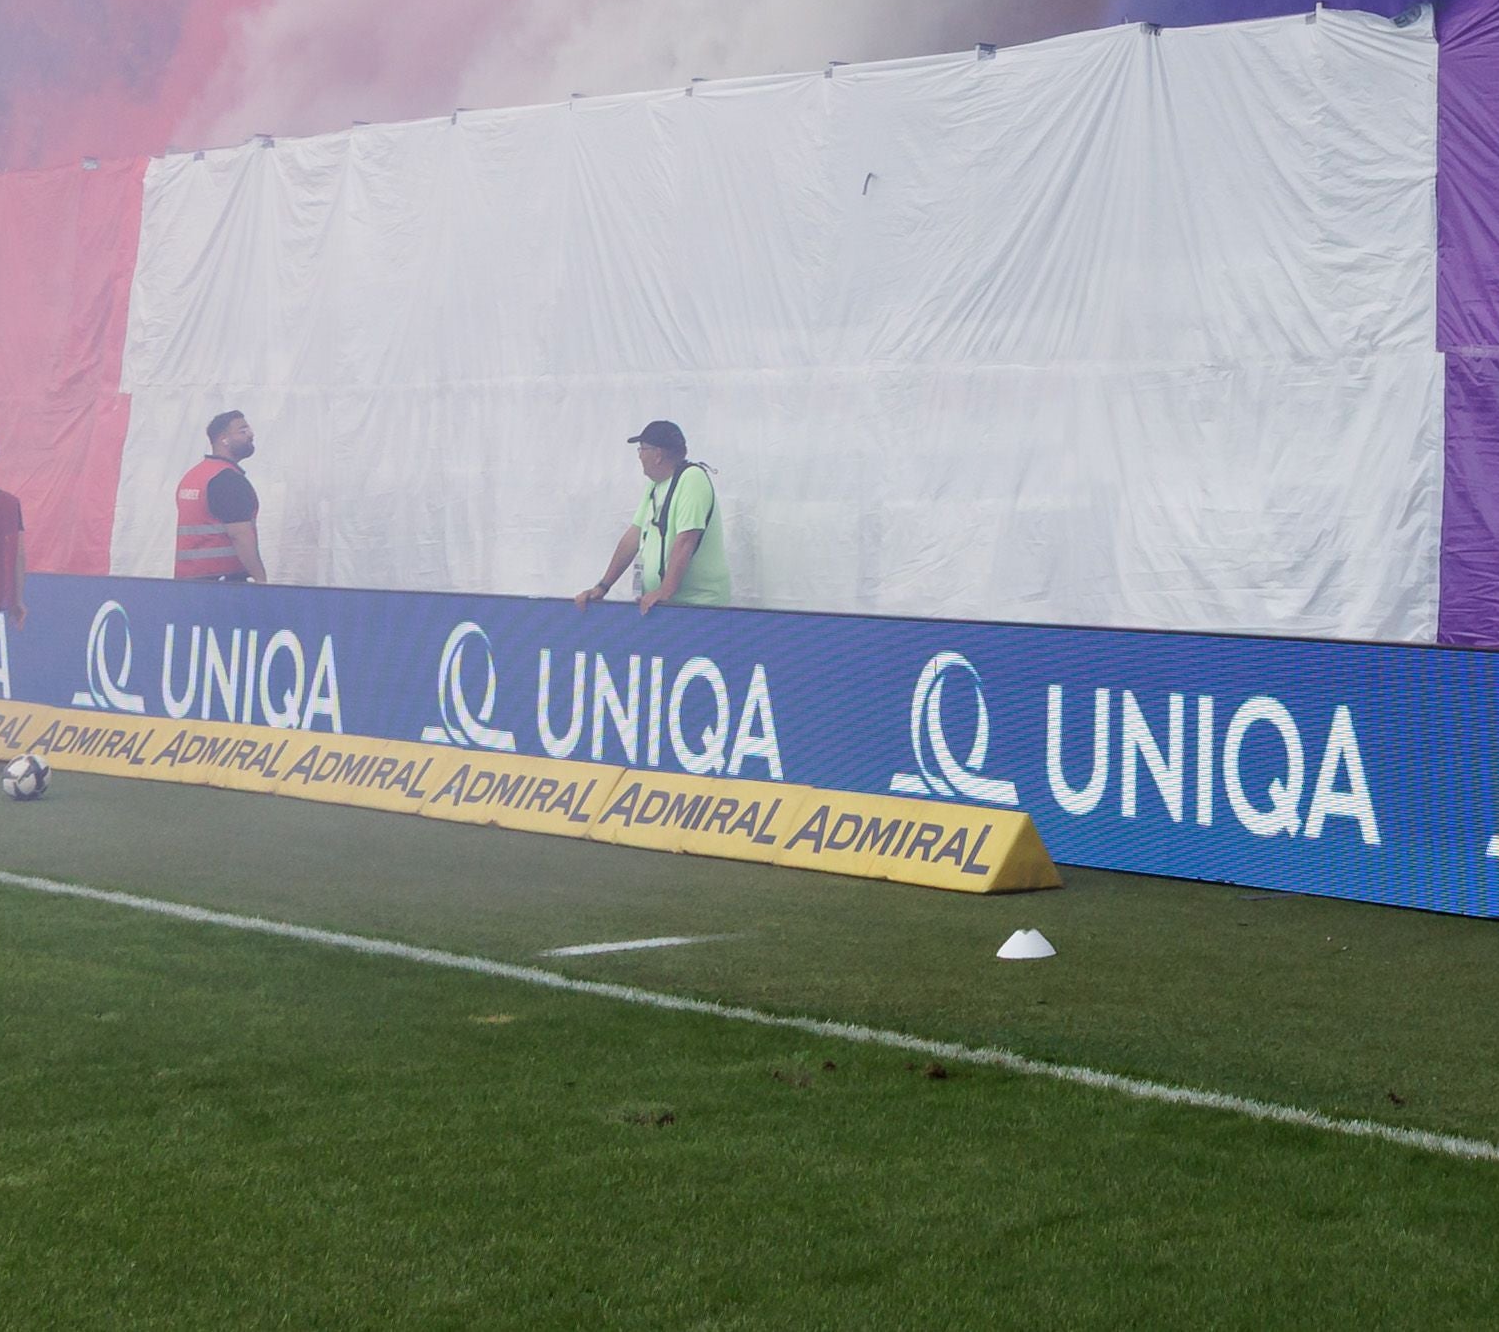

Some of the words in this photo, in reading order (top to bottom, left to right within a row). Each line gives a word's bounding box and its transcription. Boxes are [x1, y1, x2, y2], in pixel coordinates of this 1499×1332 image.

[162, 623, 343, 734] UNIQA
[26, 719, 155, 765] ADMIRAL
[537, 648, 784, 780] UNIQA
[151, 729, 288, 777] ADMIRAL
[282, 744, 435, 799] ADMIRAL
[1046, 685, 1382, 845] UNIQA
[430, 763, 598, 823] ADMIRAL
[598, 782, 783, 846] ADMIRAL
[786, 805, 992, 877] ADMIRAL
